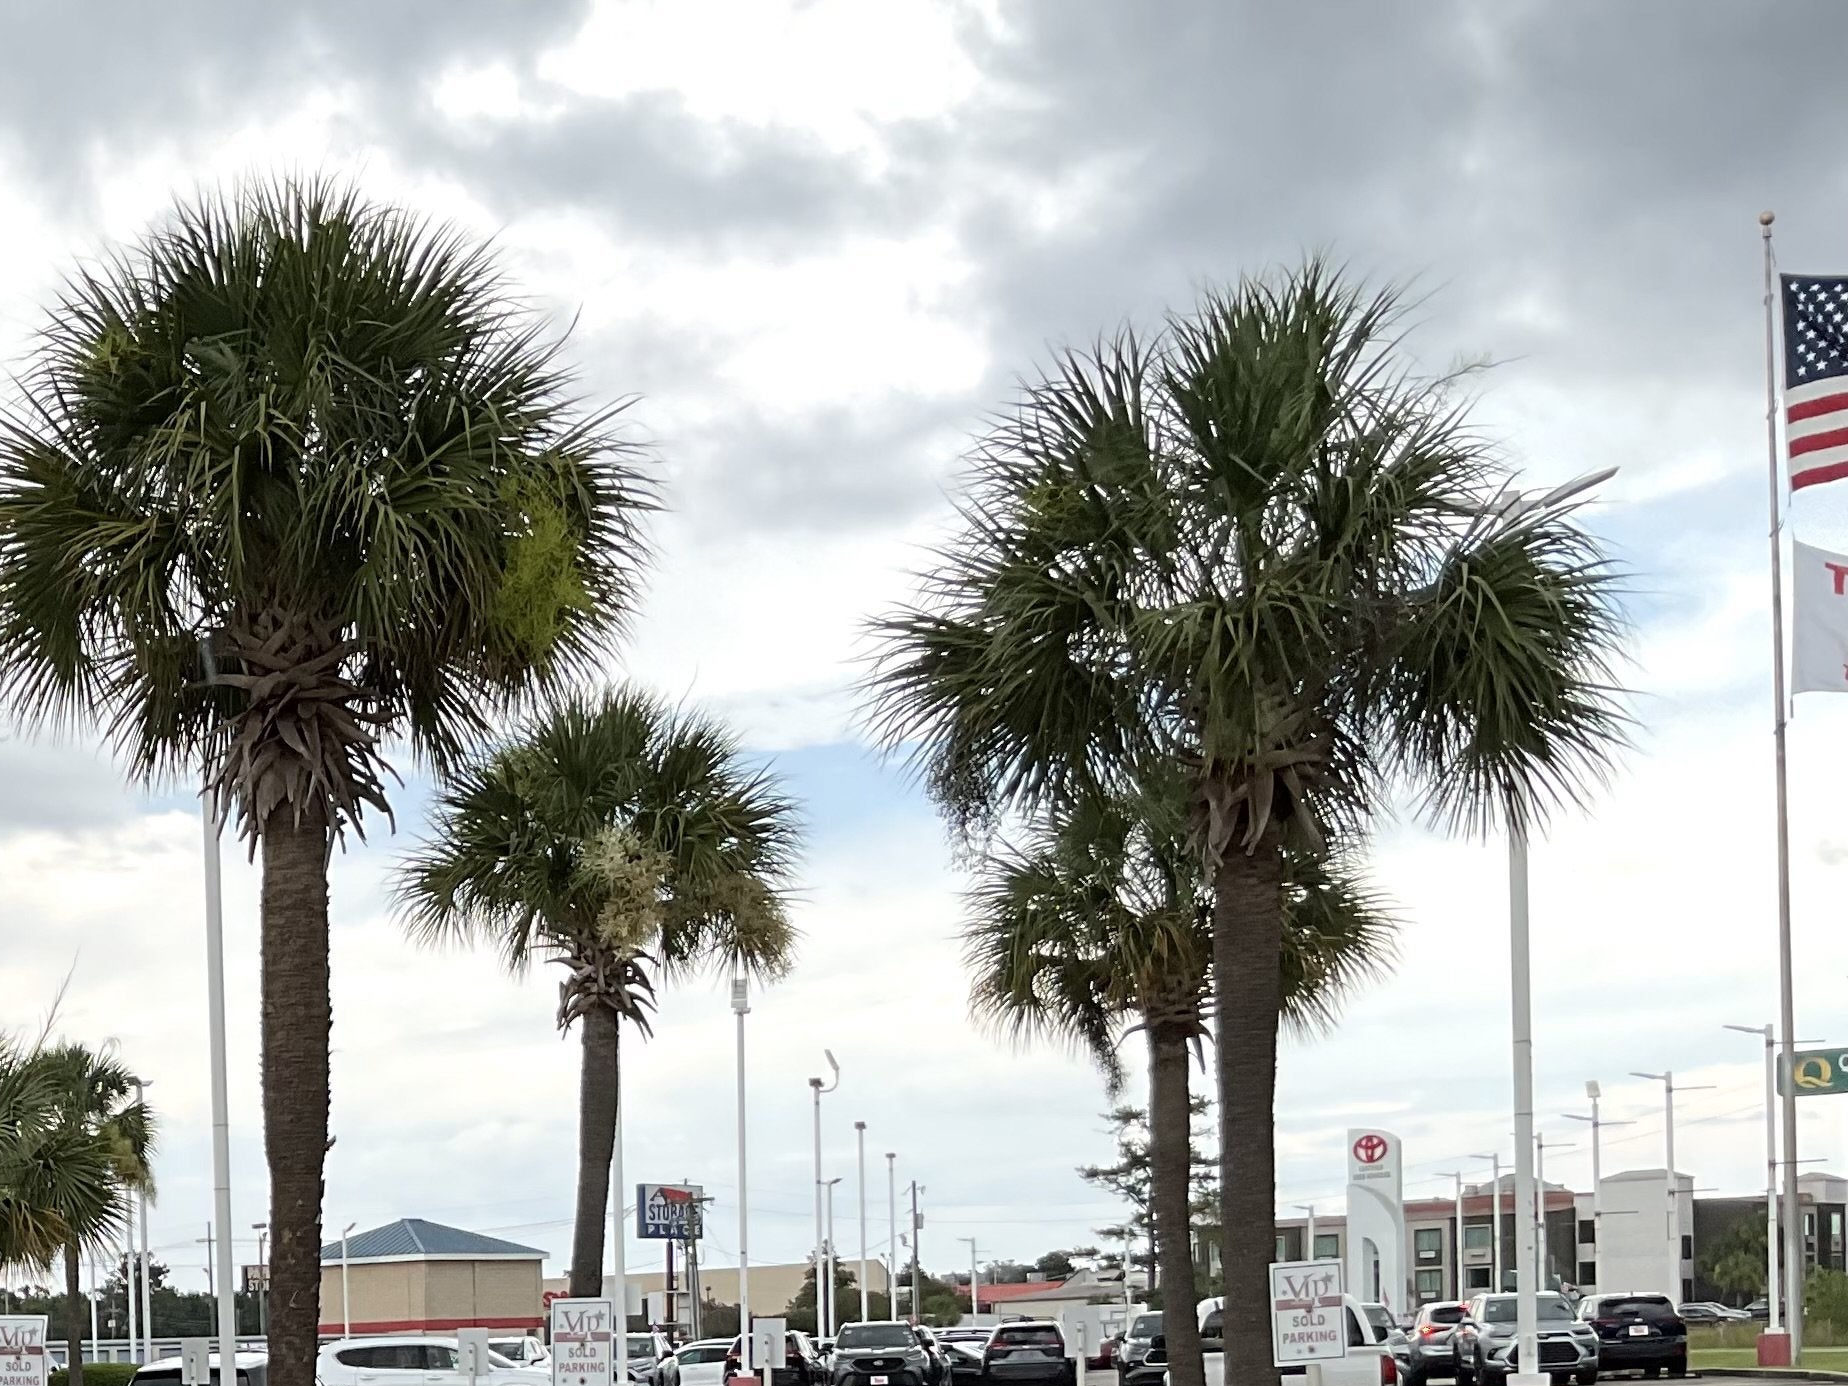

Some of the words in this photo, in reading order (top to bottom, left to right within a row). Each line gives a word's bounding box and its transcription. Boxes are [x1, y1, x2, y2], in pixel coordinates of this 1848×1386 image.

[1292, 1314, 1325, 1328] SOLD
[1282, 1330, 1337, 1344] PARKING
[568, 1347, 597, 1358] SOLD
[6, 1362, 31, 1372] SOLD
[559, 1362, 605, 1373] PARKING
